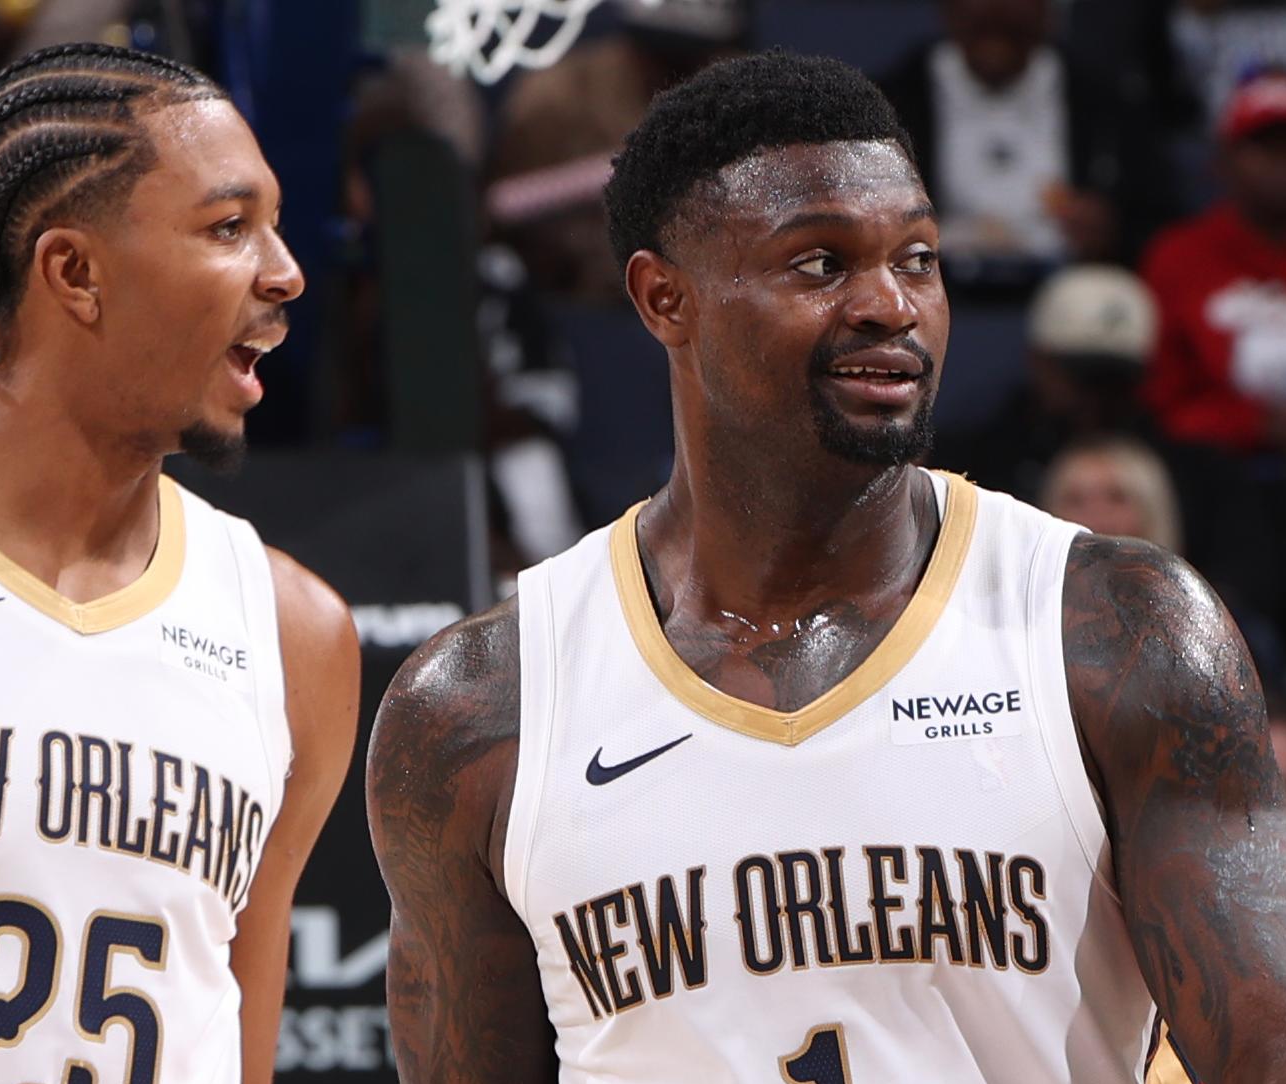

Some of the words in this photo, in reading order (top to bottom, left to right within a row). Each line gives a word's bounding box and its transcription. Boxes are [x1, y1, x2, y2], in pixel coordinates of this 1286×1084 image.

[161, 624, 247, 670] NEWAGE
[184, 656, 227, 682] GRILLS
[892, 690, 1021, 721] NEWAGE
[925, 721, 993, 739] GRILLS
[36, 729, 264, 915] ORLEANS
[553, 865, 708, 1020] NEW
[733, 845, 1051, 976] ORLEANS
